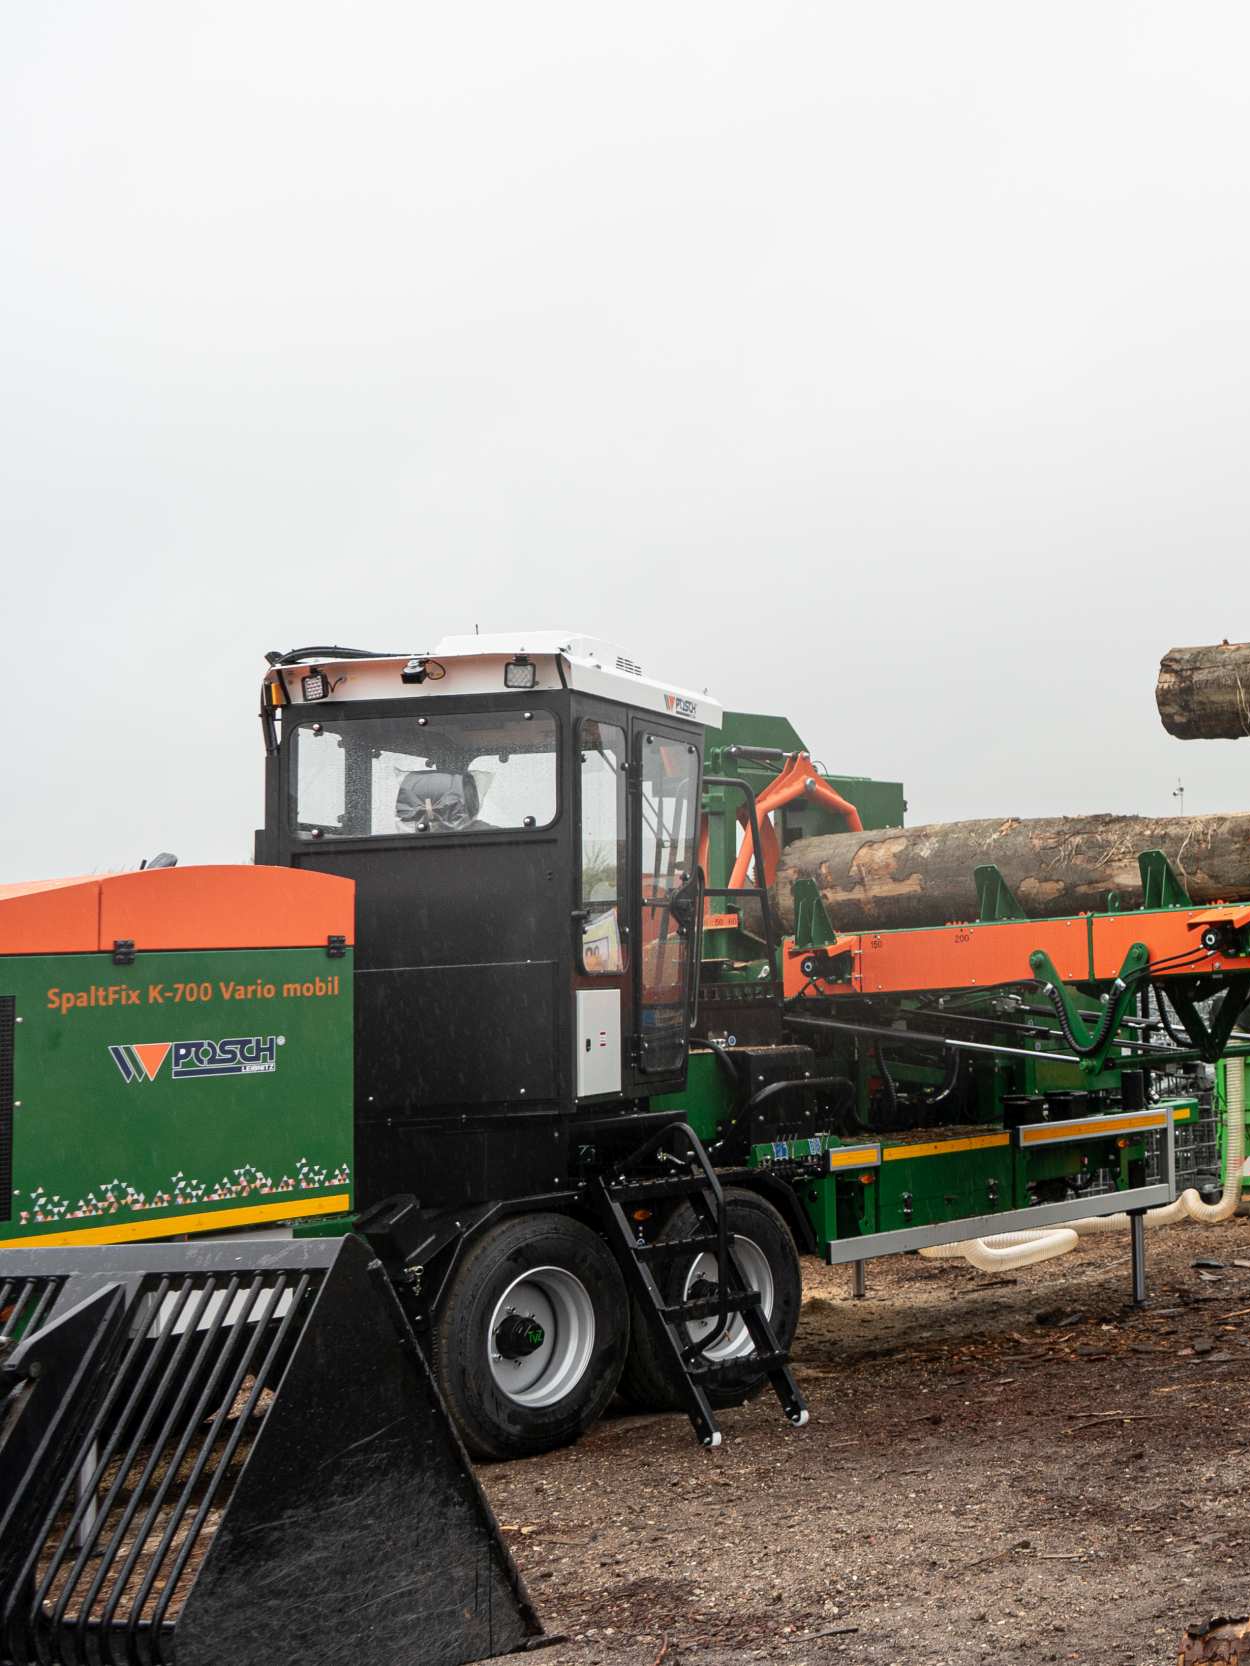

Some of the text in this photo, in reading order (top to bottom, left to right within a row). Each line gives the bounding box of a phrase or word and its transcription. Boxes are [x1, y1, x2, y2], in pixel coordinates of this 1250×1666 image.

[870, 940, 882, 949] 150
[954, 934, 970, 944] 200
[47, 976, 339, 1015] SpaltFix K-700 Vario mobil
[172, 1036, 276, 1069] POSCH
